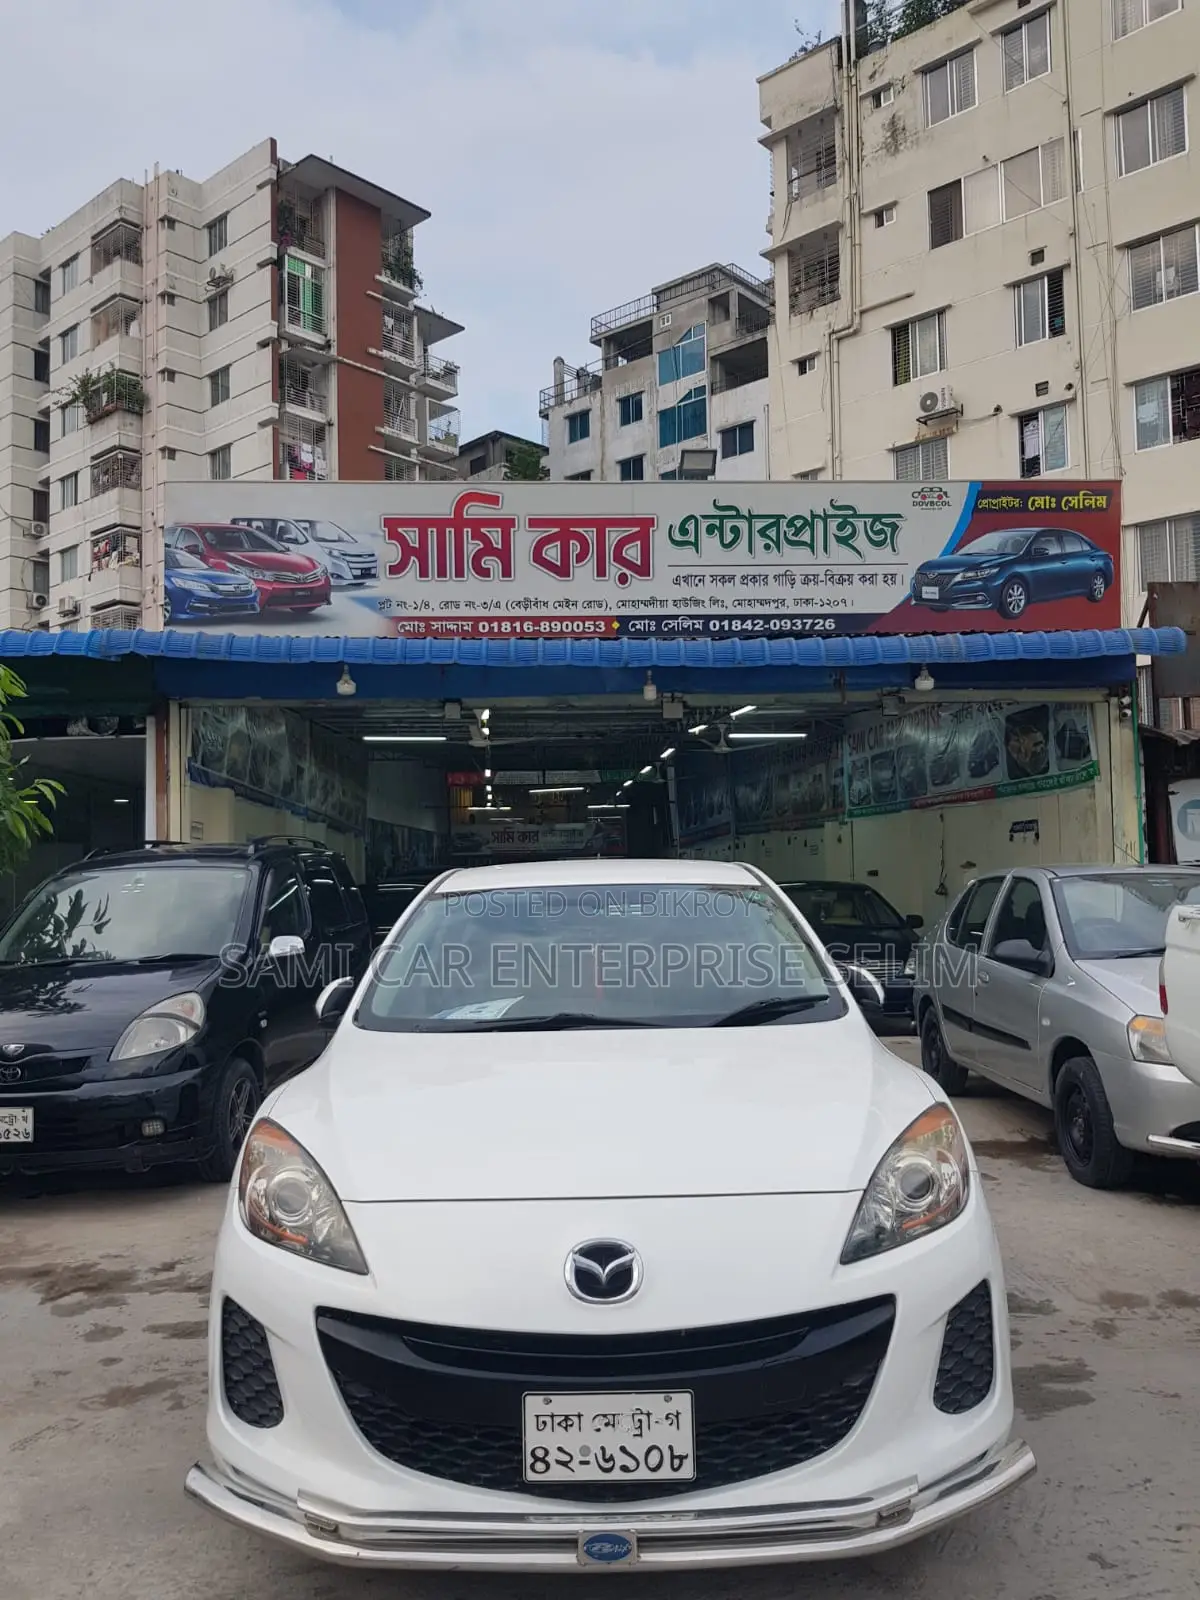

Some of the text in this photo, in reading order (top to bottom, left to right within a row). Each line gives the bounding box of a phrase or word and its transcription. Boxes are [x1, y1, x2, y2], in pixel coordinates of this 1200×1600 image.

[1027, 494, 1057, 511] মোঃ
[1060, 489, 1108, 510] সেলিম
[668, 499, 905, 558] এন্টারপ্রাইজ
[380, 489, 657, 588] সামি কার
[672, 573, 705, 587] এখানে
[709, 574, 736, 588] সকল
[739, 574, 769, 588] প্রকার
[773, 570, 796, 589] গাড়ি
[858, 573, 878, 586] করা
[439, 600, 461, 610] রোড
[552, 598, 578, 610] মেইন
[672, 597, 705, 609] হাউজিং
[397, 621, 606, 634] মোঃ সাদ্দাম 01816-890053
[628, 618, 836, 632] মোঃ সেলিম 01842-093726
[491, 828, 516, 844] সামি
[516, 830, 539, 844] কার
[534, 1412, 583, 1432] ঢাকা
[529, 1444, 689, 1474] ৪২-৬১০৮
